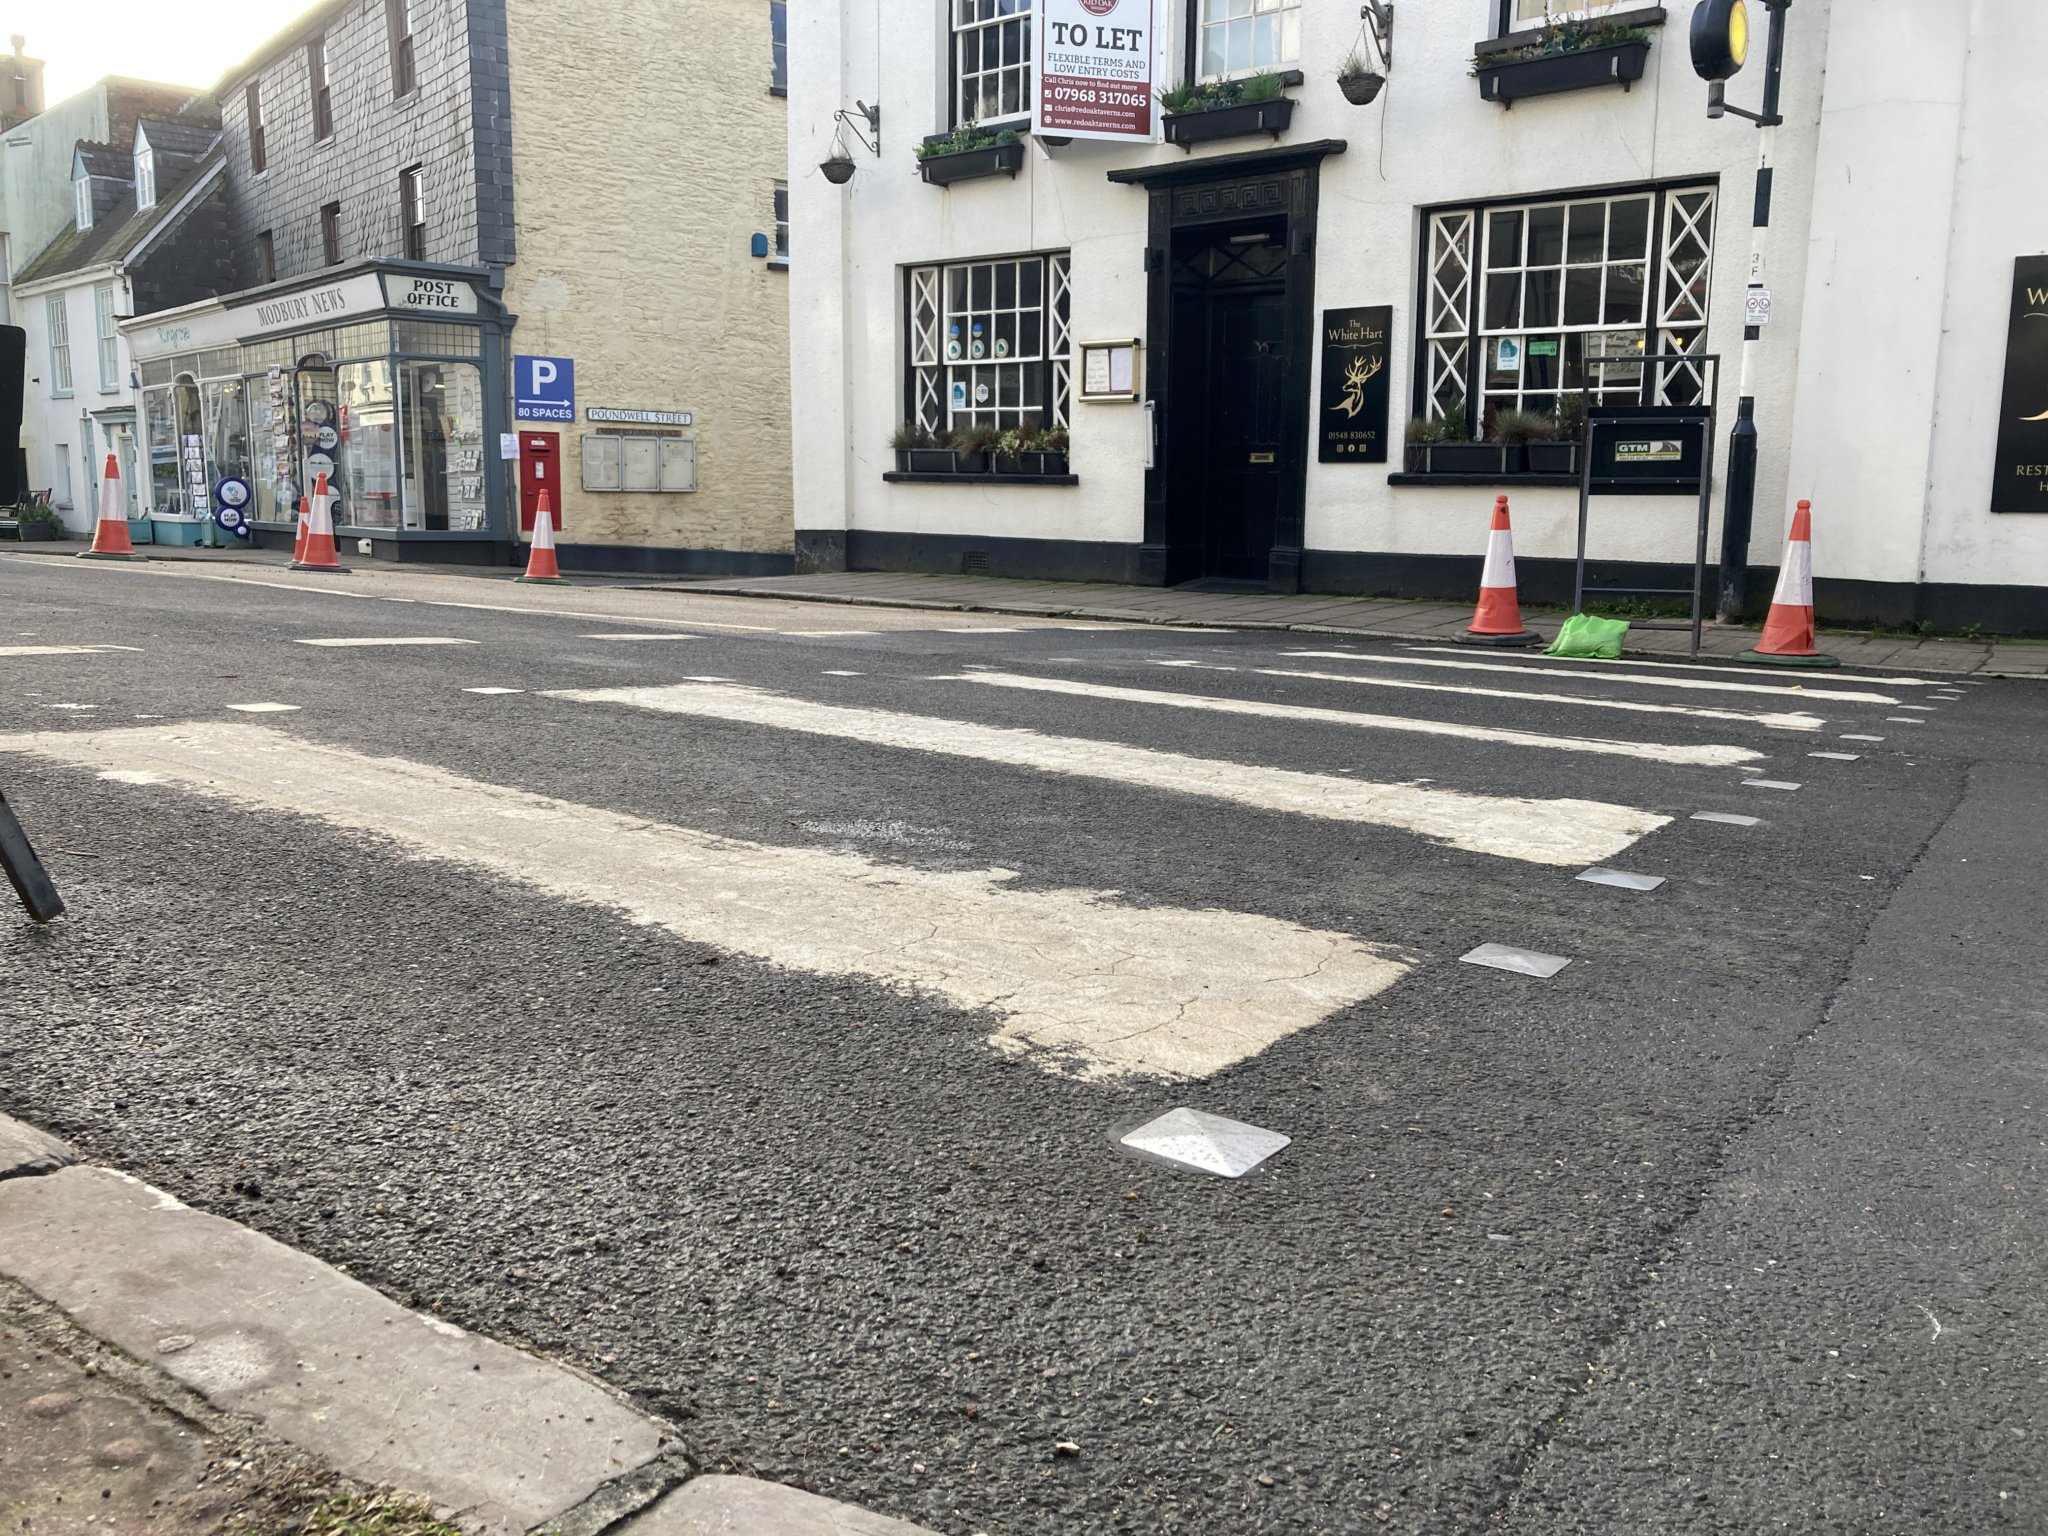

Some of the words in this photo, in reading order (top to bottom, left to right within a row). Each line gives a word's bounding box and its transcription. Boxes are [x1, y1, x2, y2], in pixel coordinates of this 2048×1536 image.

[1052, 22, 1088, 46] TO
[1096, 26, 1142, 52] LET
[1048, 52, 1090, 65] FLEXIBLE
[1092, 56, 1123, 68] TERMS
[1125, 60, 1146, 69] AND
[1054, 64, 1076, 73] LOW
[1078, 66, 1108, 77] ENTRY
[1110, 69, 1140, 79] COSTS
[1055, 87, 1096, 102] 07968
[1099, 92, 1146, 106] 317065
[1055, 105, 1135, 118] chris@redoaktaverns.com
[1055, 118, 1135, 130] www.redoaktaverns.com
[414, 280, 454, 294] POST
[407, 292, 459, 307] OFFICE
[257, 296, 309, 326] MODBURY
[312, 288, 346, 314] NEWS
[1350, 320, 1360, 328] The
[1328, 328, 1358, 340] White
[1361, 327, 1382, 339] Hart
[532, 360, 558, 395] P
[518, 408, 530, 417] 80
[532, 408, 572, 419] SPACES
[592, 410, 650, 421] POUNDWELL
[655, 412, 688, 423] STREET
[1328, 432, 1348, 440] 01548
[1350, 431, 1375, 439] 830652
